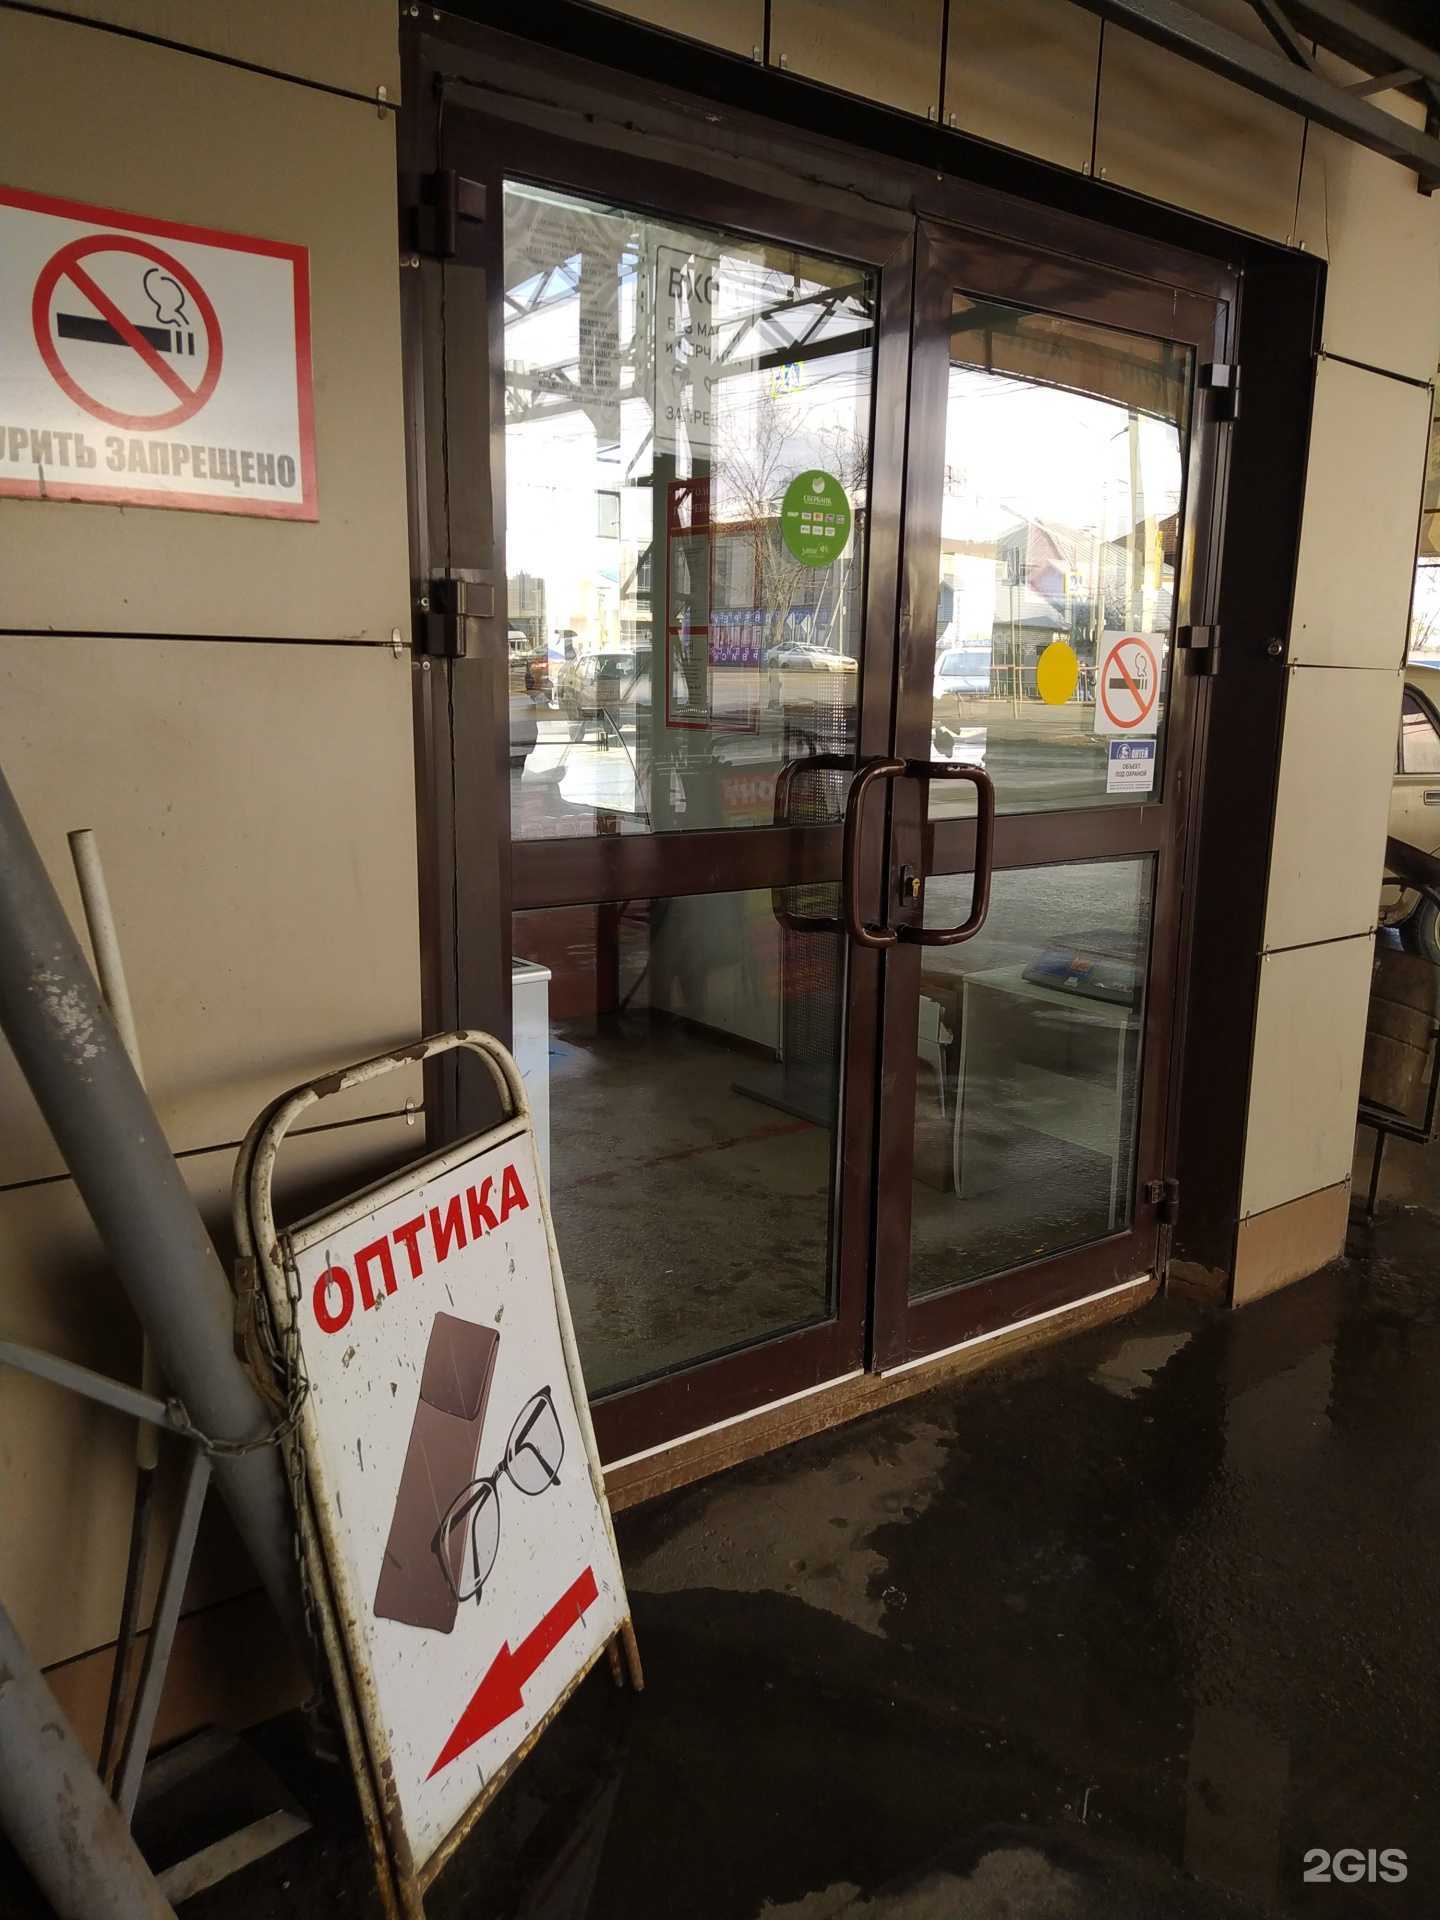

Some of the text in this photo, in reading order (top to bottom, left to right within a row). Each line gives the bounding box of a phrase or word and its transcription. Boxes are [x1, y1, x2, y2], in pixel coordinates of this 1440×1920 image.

[667, 266, 720, 305] ВХО
[0, 426, 296, 488] РИТЬ ЗАПРЕЩЕНО
[312, 1163, 530, 1334] ОПТИКА
